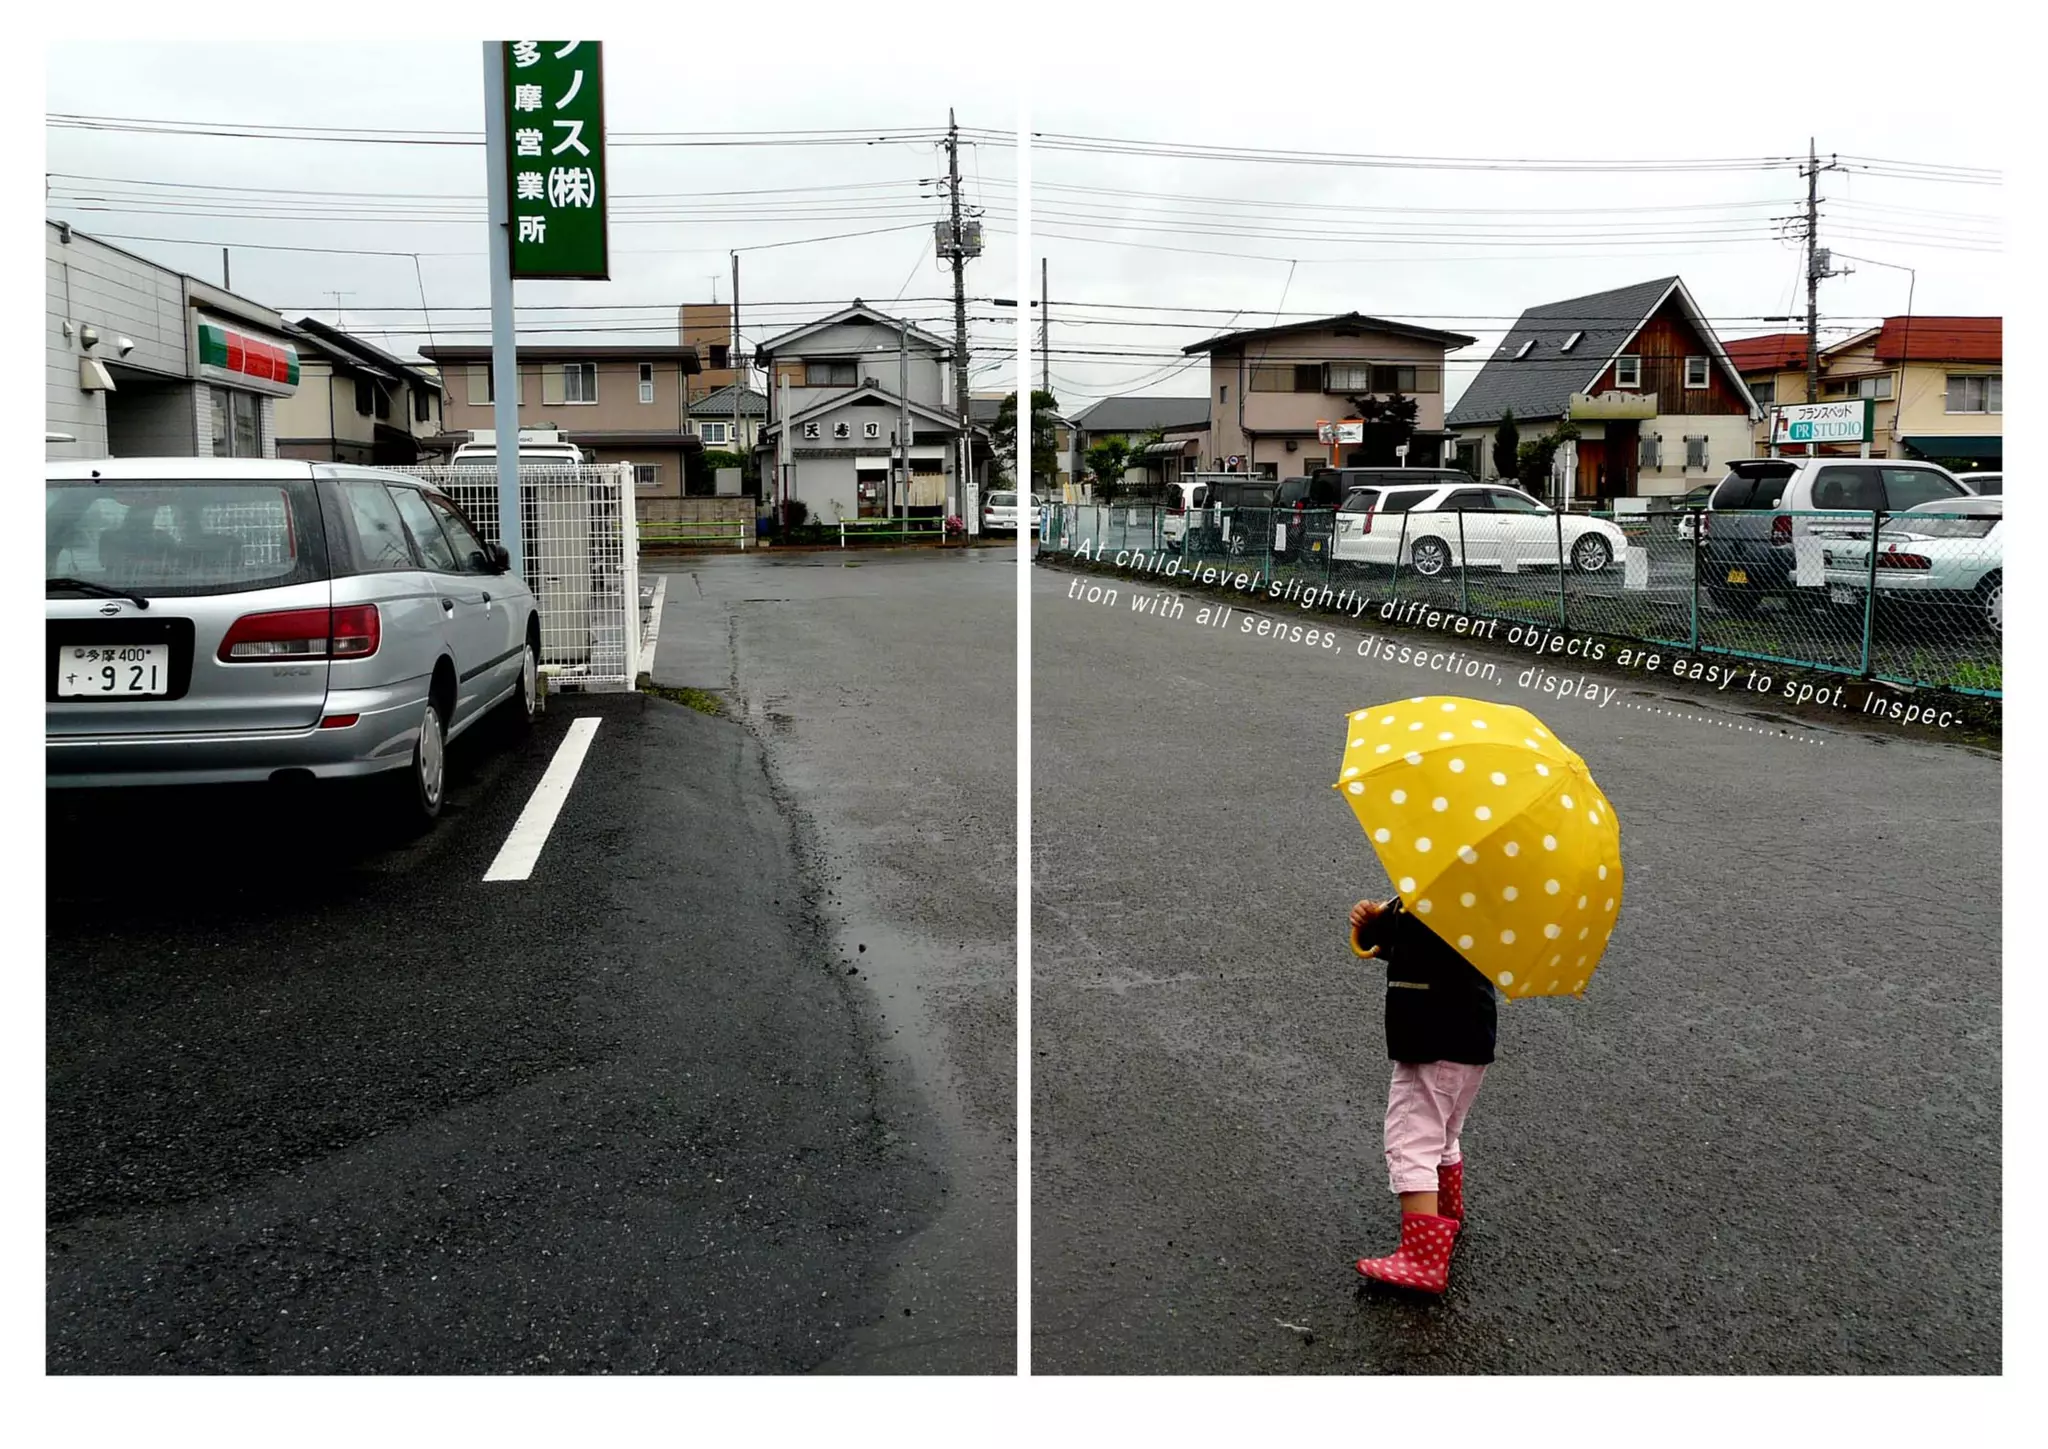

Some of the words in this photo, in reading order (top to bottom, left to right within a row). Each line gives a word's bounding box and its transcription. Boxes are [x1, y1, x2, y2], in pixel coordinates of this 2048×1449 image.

[512, 40, 547, 244] 多摩営業所
[1798, 404, 1852, 420] フランスベッド
[805, 422, 879, 437] 天寿司
[1795, 424, 1810, 438] PR
[1813, 421, 1862, 437] STUDIO
